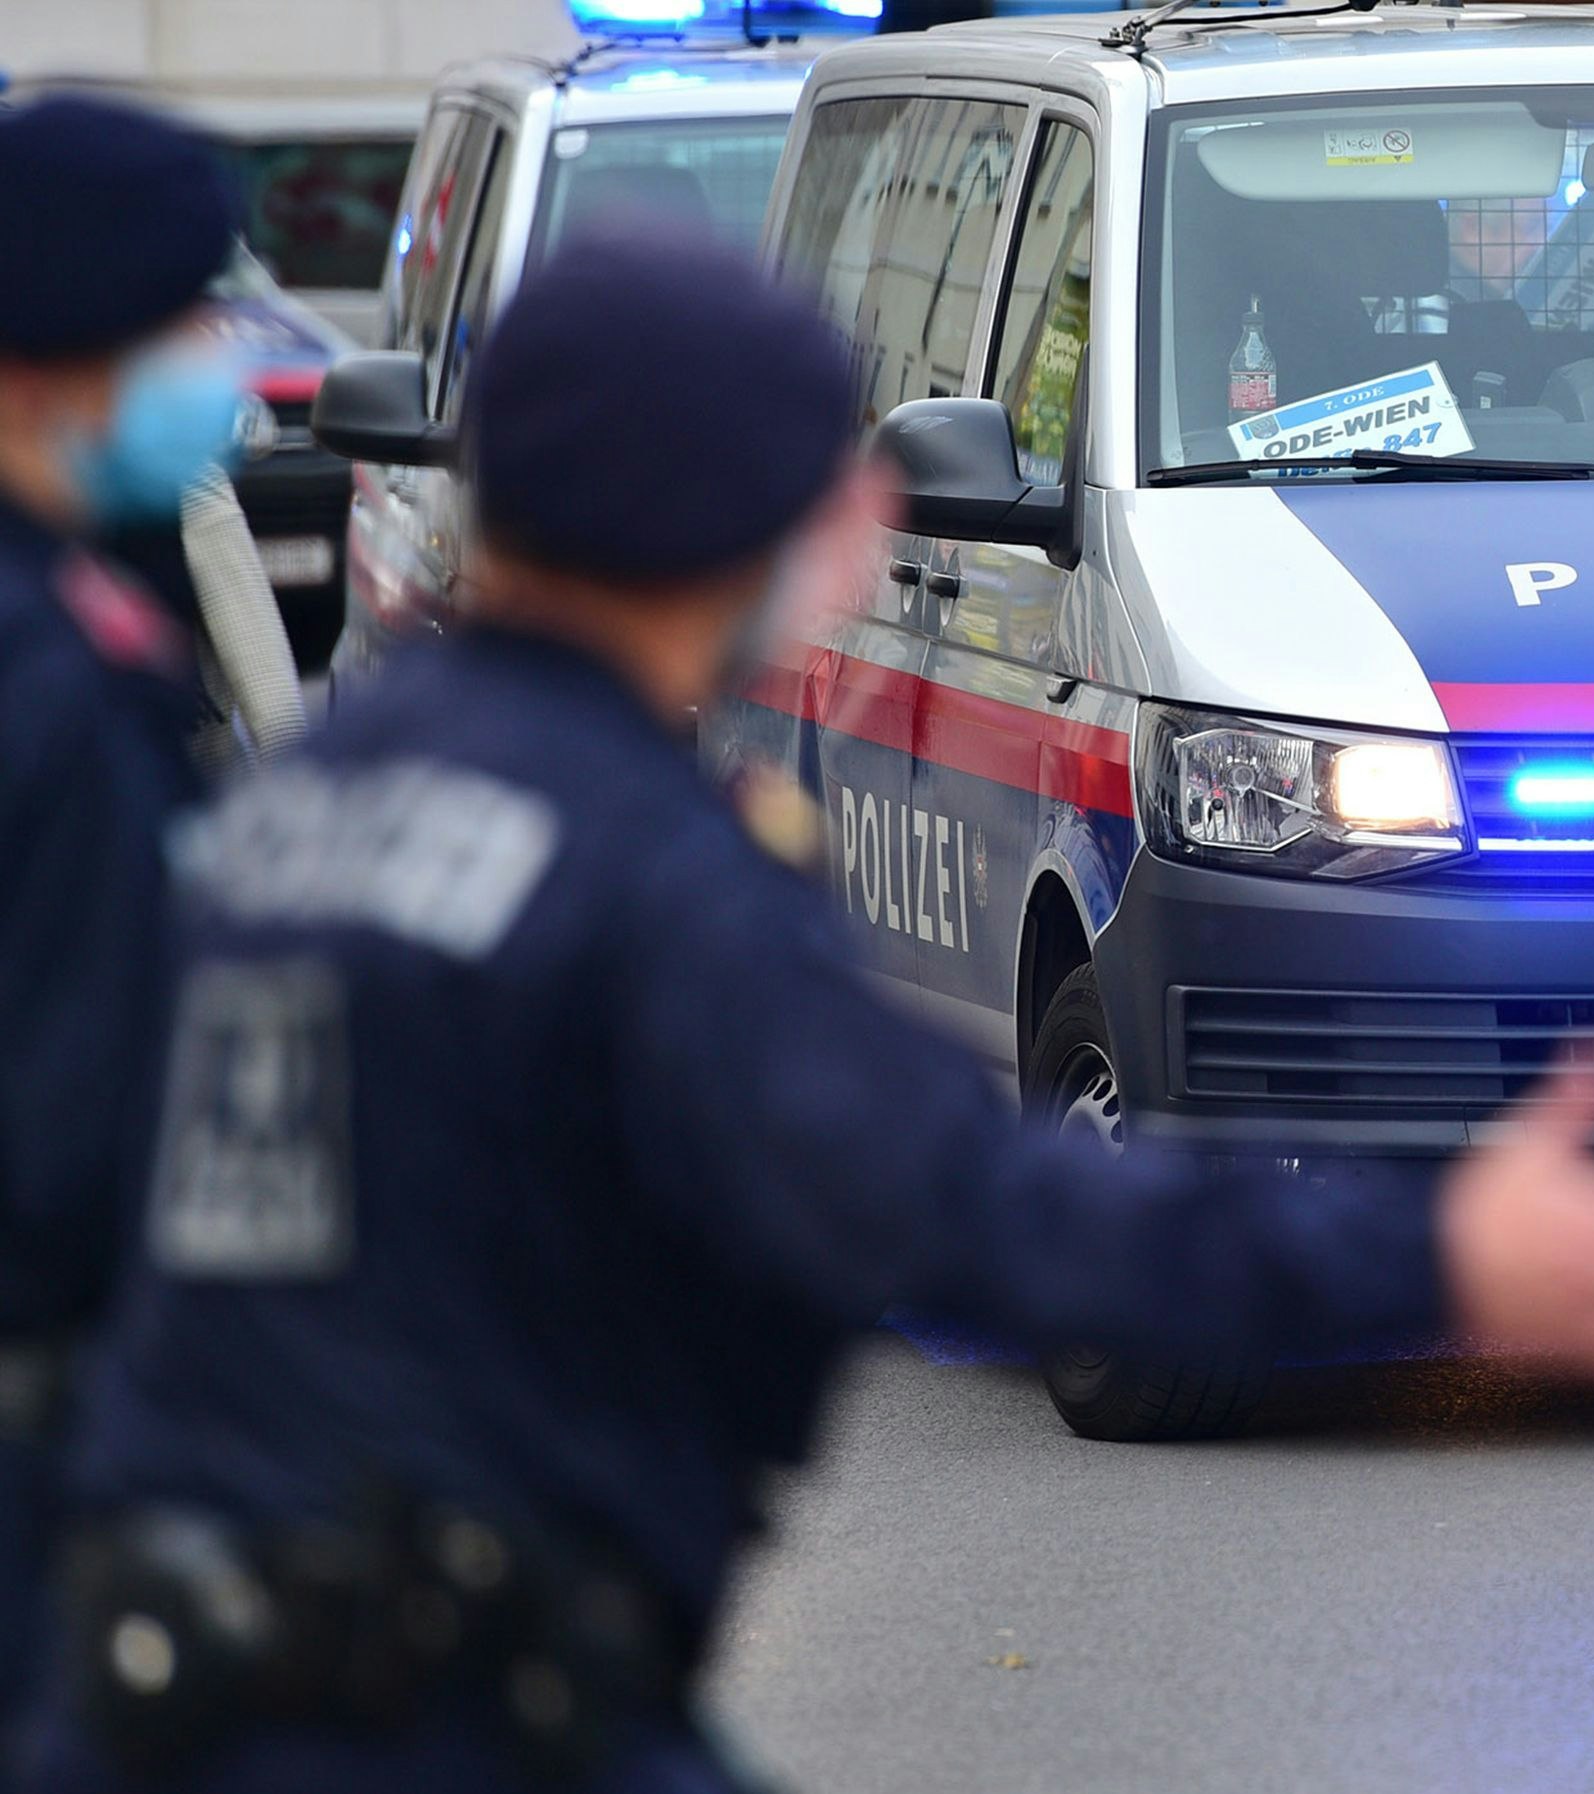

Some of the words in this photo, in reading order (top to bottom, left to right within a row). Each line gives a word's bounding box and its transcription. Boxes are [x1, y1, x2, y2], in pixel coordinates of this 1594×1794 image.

[1323, 401, 1339, 411] 7.
[1343, 385, 1385, 405] ODE
[1263, 395, 1430, 459] ODE-WIEN
[1383, 422, 1442, 451] 847
[841, 785, 970, 953] POLIZEI
